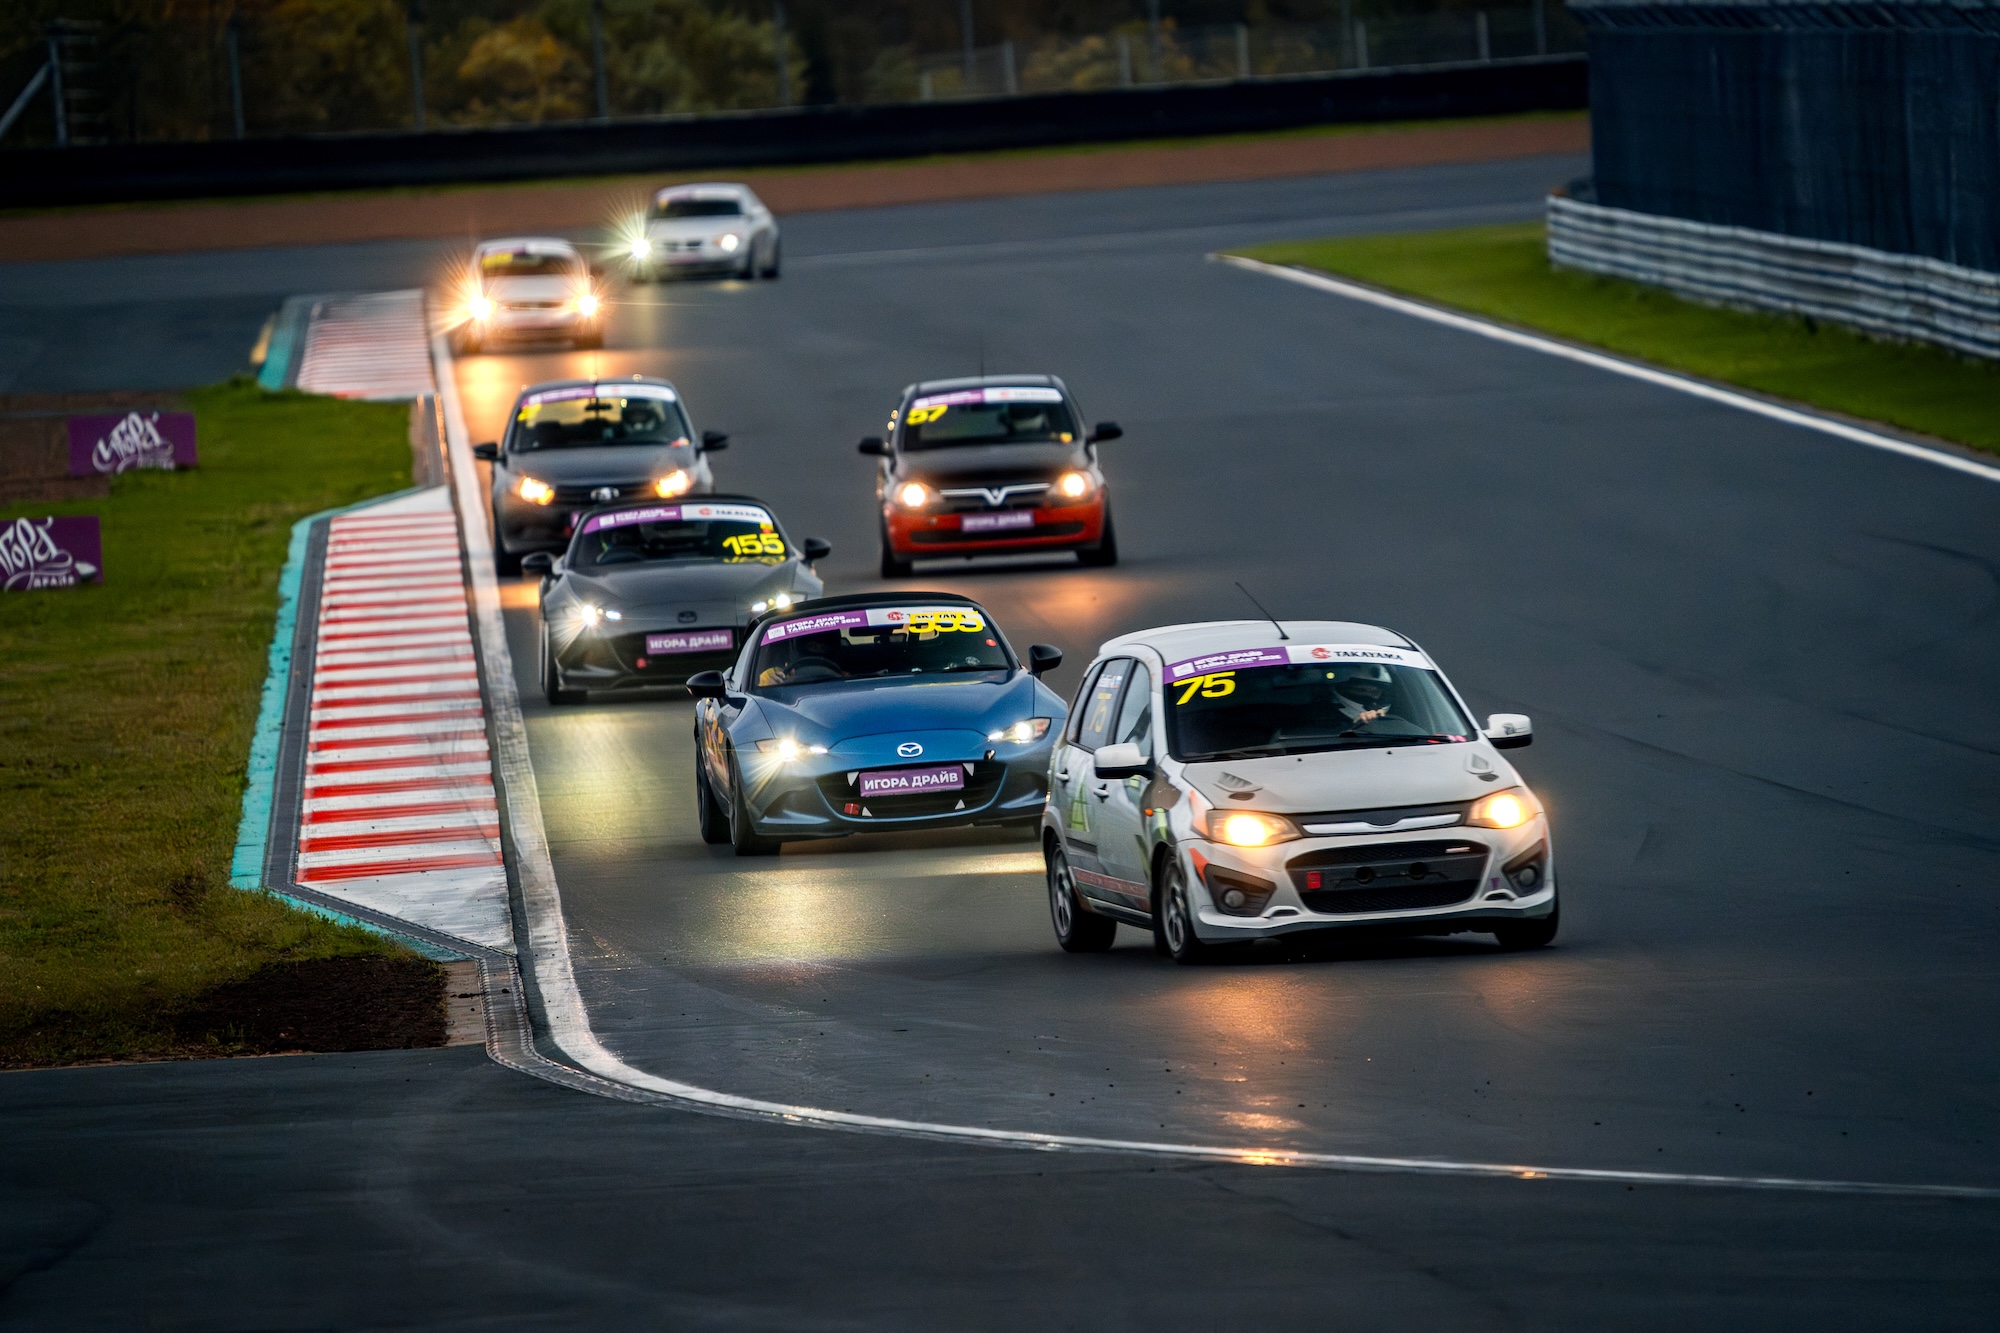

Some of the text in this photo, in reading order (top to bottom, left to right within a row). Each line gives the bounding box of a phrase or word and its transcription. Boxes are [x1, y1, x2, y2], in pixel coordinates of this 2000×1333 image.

[722, 533, 786, 556] 155
[908, 610, 984, 633] 555
[1334, 651, 1404, 661] TAKAYAMA
[1173, 671, 1236, 705] 75
[864, 771, 958, 790] ИГОРА ДРАЙВ
